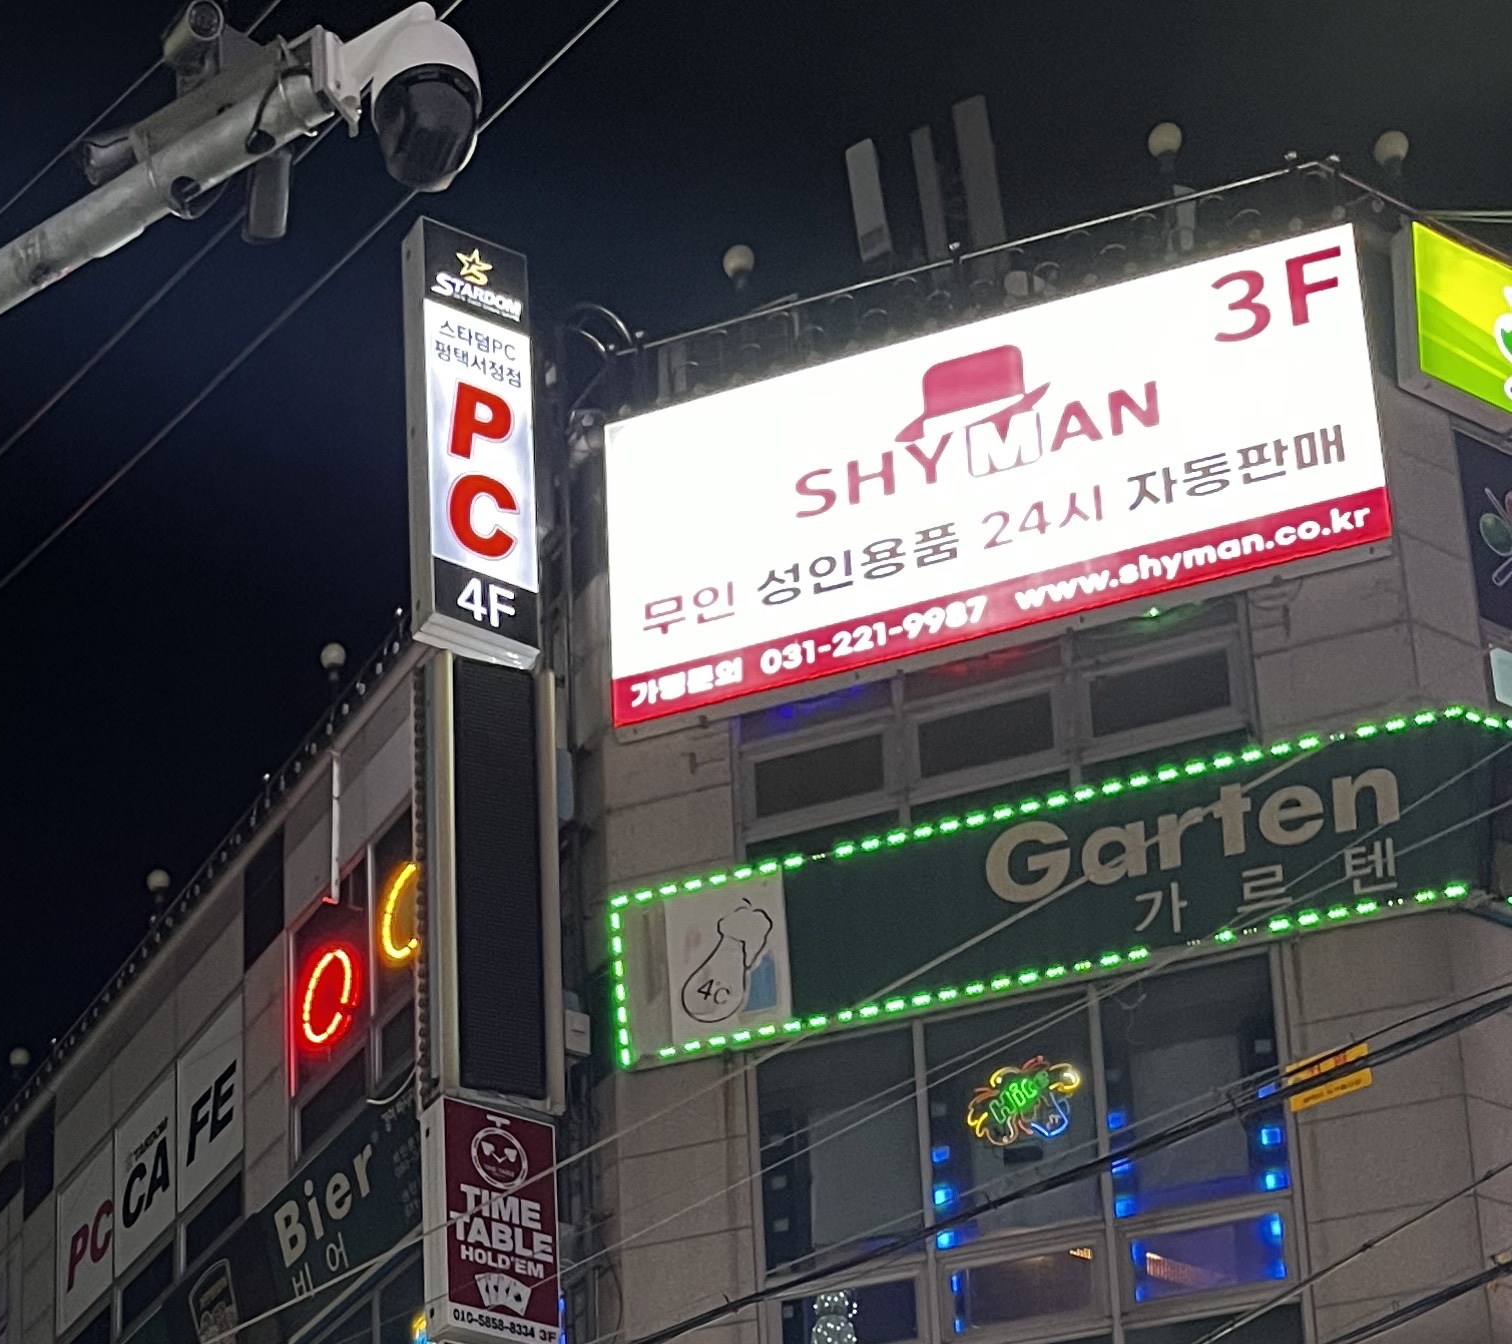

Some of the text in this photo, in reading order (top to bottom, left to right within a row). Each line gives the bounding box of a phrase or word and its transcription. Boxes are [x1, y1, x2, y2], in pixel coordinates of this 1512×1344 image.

[431, 272, 524, 316] STARDOM
[1210, 247, 1343, 343] 3F
[448, 379, 520, 560] PC
[794, 380, 1162, 519] SHYMAN
[642, 424, 1347, 635] 무인 성인용품 24시 자동판매
[457, 578, 516, 628] 4F
[759, 595, 988, 676] 031-221-9987
[1015, 502, 1372, 615] www.shyman.co.kr
[985, 767, 1402, 906] Garten
[66, 1200, 114, 1295] PC
[122, 1060, 237, 1229] CAFE
[274, 1143, 373, 1269] Bier
[460, 1183, 542, 1231] TIME
[450, 1210, 554, 1264] TABLE
[460, 1243, 545, 1279] HOLD'EM
[540, 1329, 557, 1343] 3F
